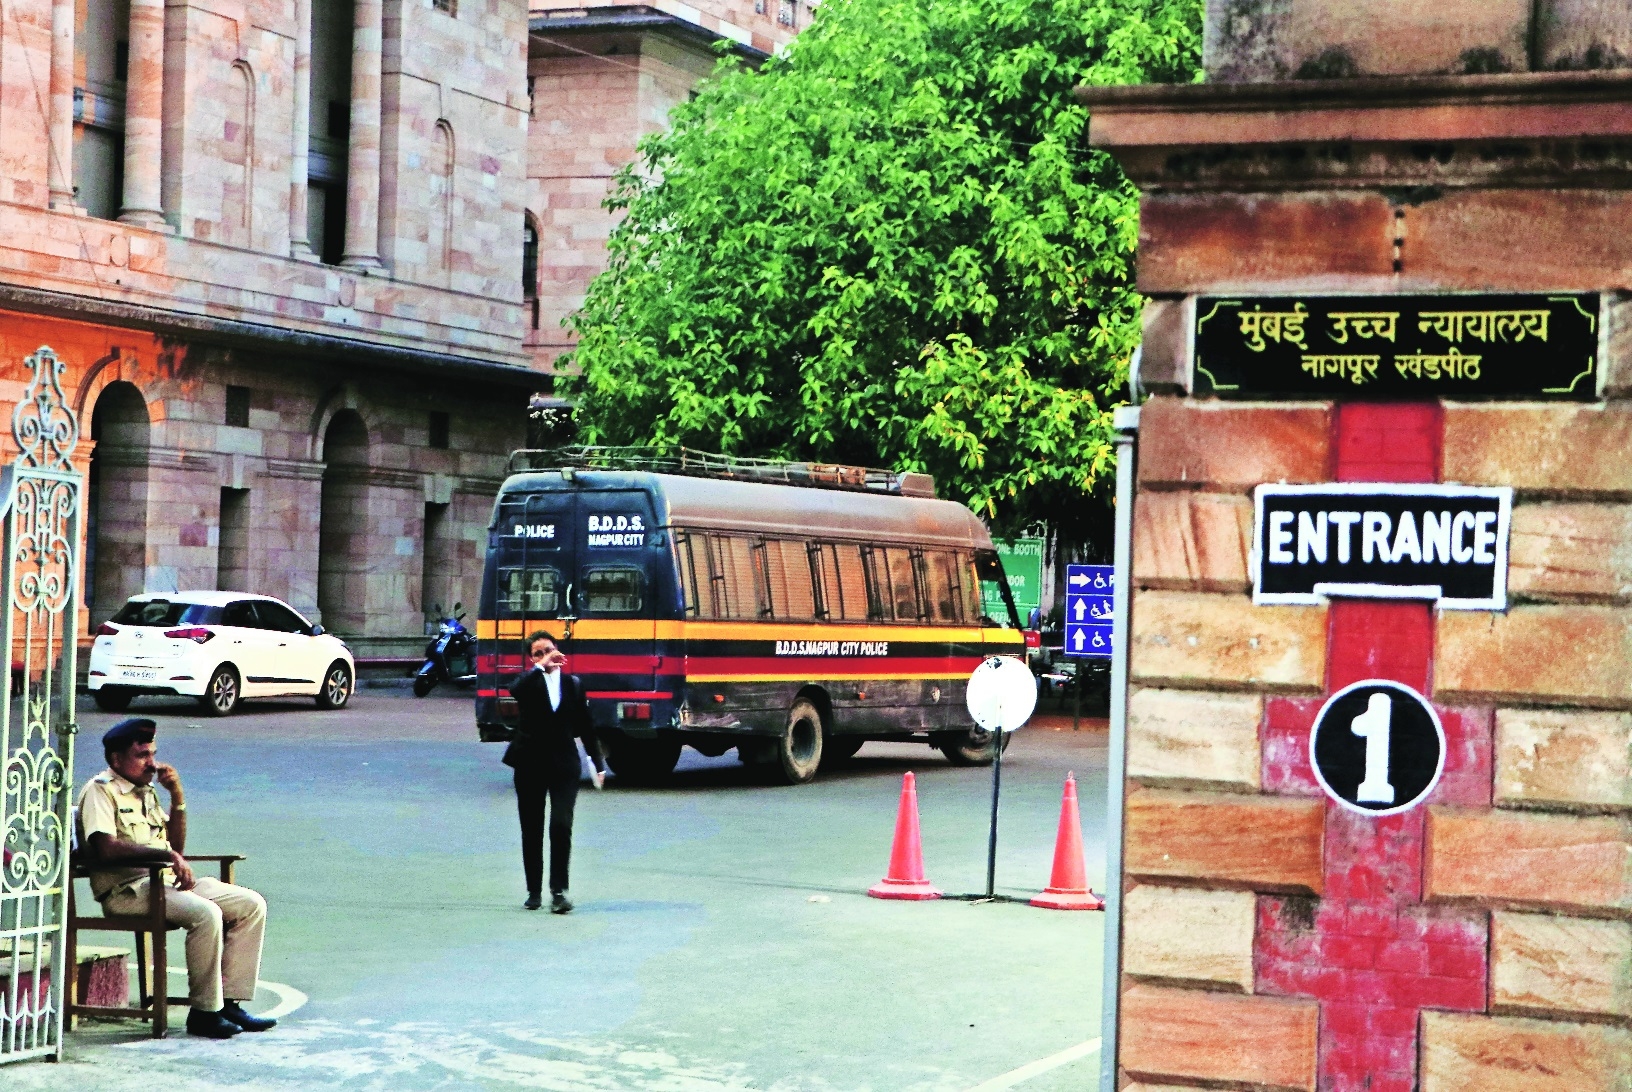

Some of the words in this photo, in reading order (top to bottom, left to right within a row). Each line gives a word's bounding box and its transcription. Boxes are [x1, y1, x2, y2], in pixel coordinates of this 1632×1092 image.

[1237, 302, 1309, 352] मुंबई
[1325, 312, 1400, 344] उच्च
[1418, 310, 1551, 343] न्यायालय
[1301, 355, 1381, 385] नागपूर
[1394, 346, 1482, 380] खंडपीठ
[515, 525, 555, 538] POLICE
[588, 515, 645, 531] B.D.D.S.
[1269, 510, 1496, 564] ENTRANCE
[841, 641, 860, 656] CITY
[860, 641, 888, 656] POLICE
[1351, 692, 1395, 804] 1
